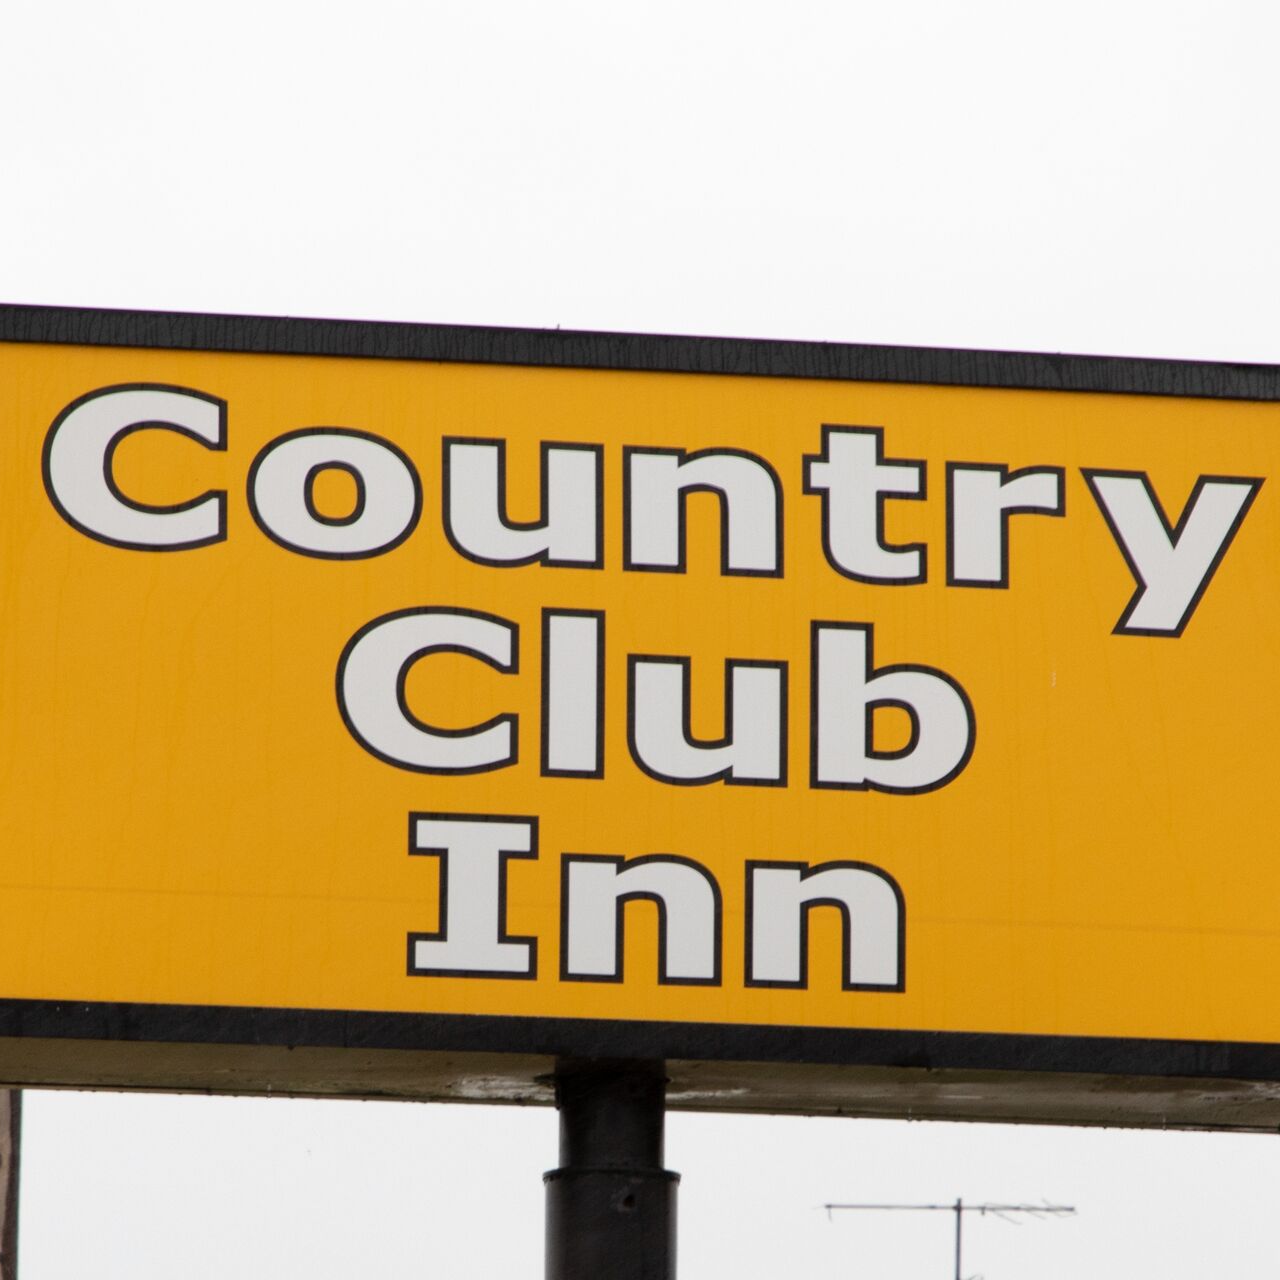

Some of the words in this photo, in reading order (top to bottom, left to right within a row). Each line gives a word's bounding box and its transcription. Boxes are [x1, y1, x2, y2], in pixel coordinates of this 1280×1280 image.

[41, 382, 1265, 637] Country
[335, 606, 976, 795] Club
[406, 812, 906, 994] Inn
